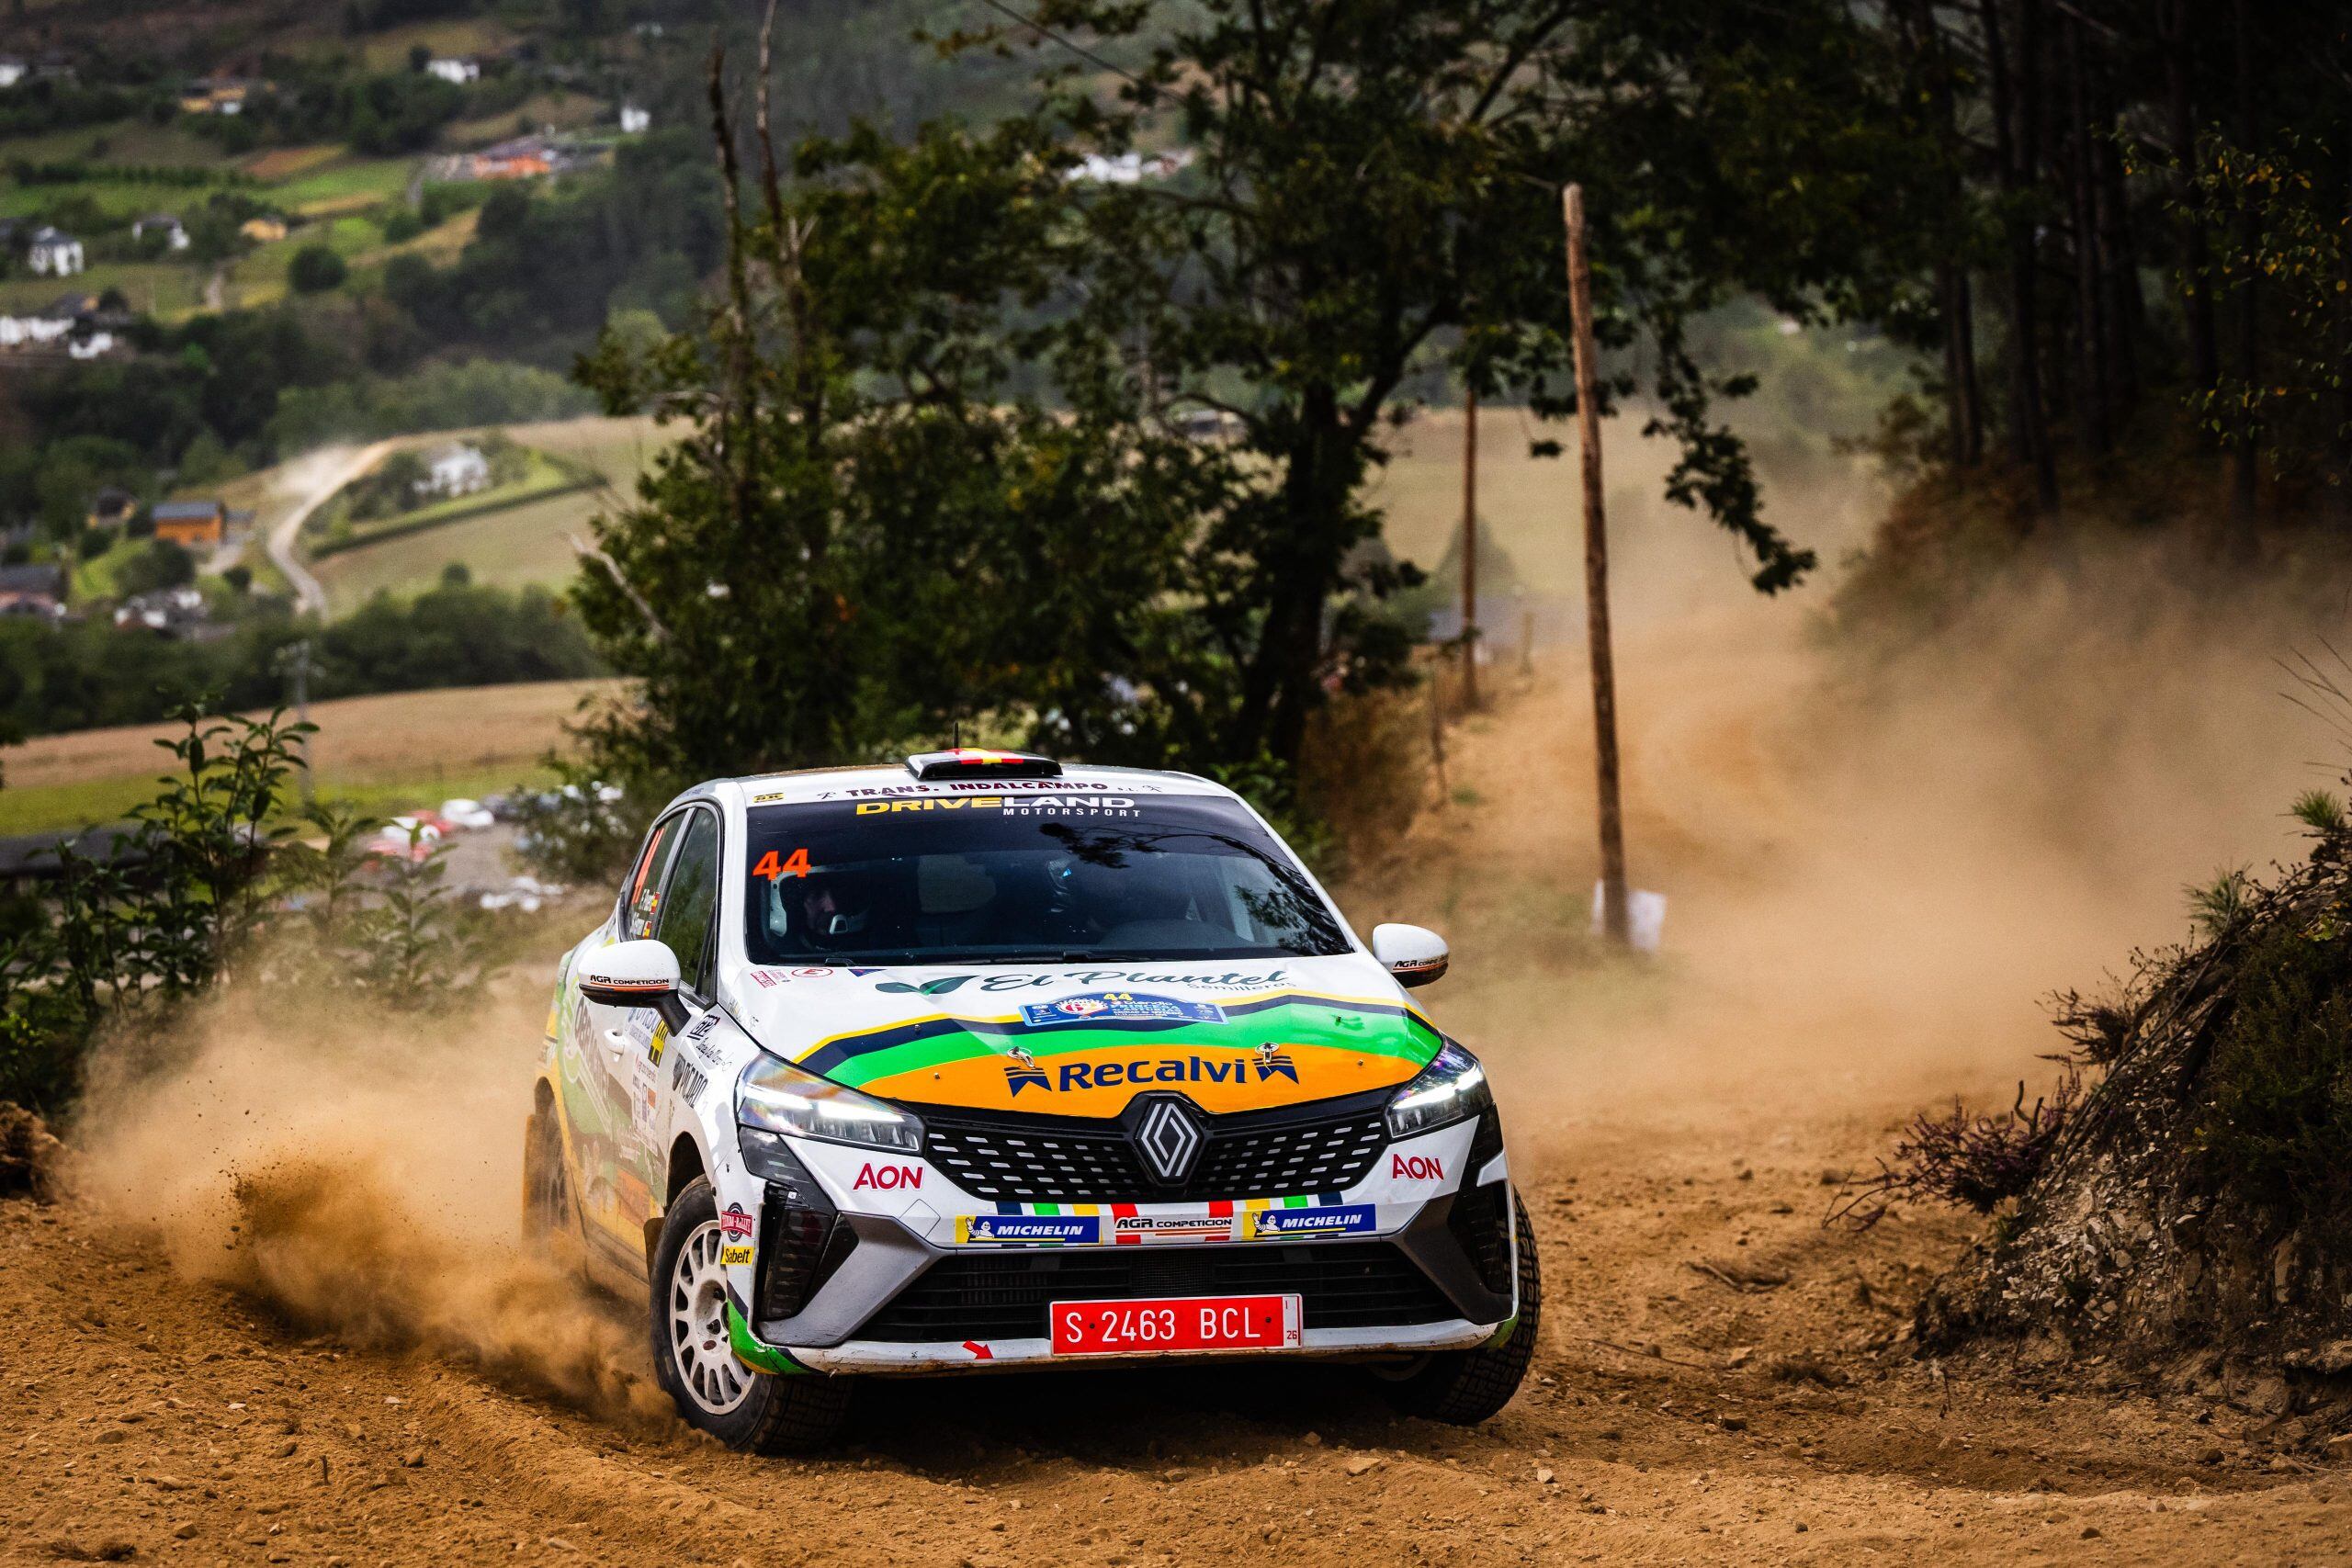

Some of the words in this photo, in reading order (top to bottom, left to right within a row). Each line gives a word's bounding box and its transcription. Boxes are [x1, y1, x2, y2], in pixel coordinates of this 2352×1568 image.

[950, 782, 1108, 791] INDALCAMPO
[856, 796, 1135, 815] DRIVELAND
[1003, 807, 1140, 818] MOTORSPORT
[752, 849, 811, 881] 44
[590, 975, 611, 984] AGR
[1064, 970, 1288, 987] Plantel
[1103, 992, 1133, 1001] 44
[1058, 1056, 1248, 1091] Recalvi
[1392, 1154, 1444, 1180] AON
[853, 1162, 923, 1190] AON
[1116, 1218, 1153, 1229] AGR
[1156, 1218, 1232, 1229] COMPETICION
[1283, 1213, 1363, 1229] MICHELIN
[996, 1225, 1084, 1235] MICHELIN
[725, 1247, 752, 1264] Sabelt
[1066, 1312, 1082, 1343] S
[1102, 1309, 1175, 1343] 2463
[1200, 1307, 1261, 1340] BCL
[1286, 1330, 1297, 1340] 26
